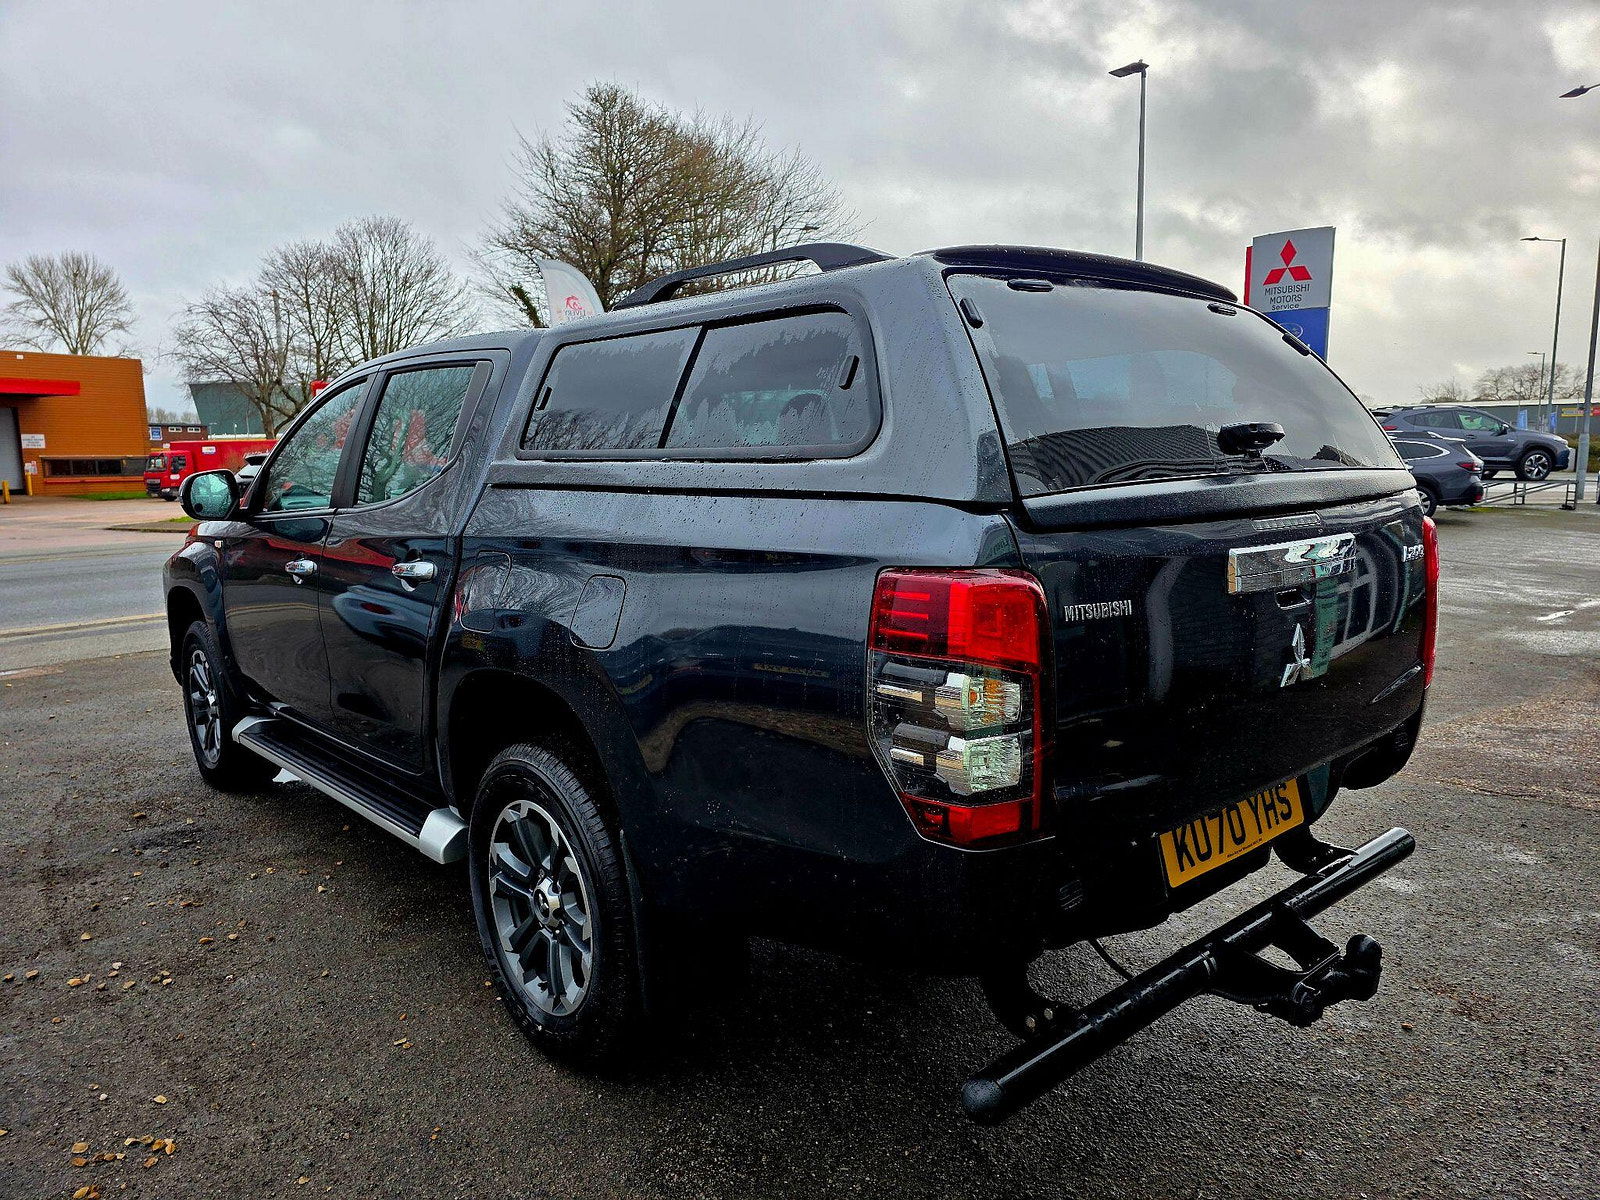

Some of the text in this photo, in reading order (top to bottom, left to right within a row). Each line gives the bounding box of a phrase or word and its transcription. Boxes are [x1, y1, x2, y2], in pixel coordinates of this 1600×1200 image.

[1264, 283, 1310, 296] MITSUBISHI
[1269, 294, 1302, 304] MOTORS
[1271, 303, 1300, 311] Service
[1063, 599, 1132, 622] MITSUBISHI
[1171, 783, 1293, 873] KU70 YHS
